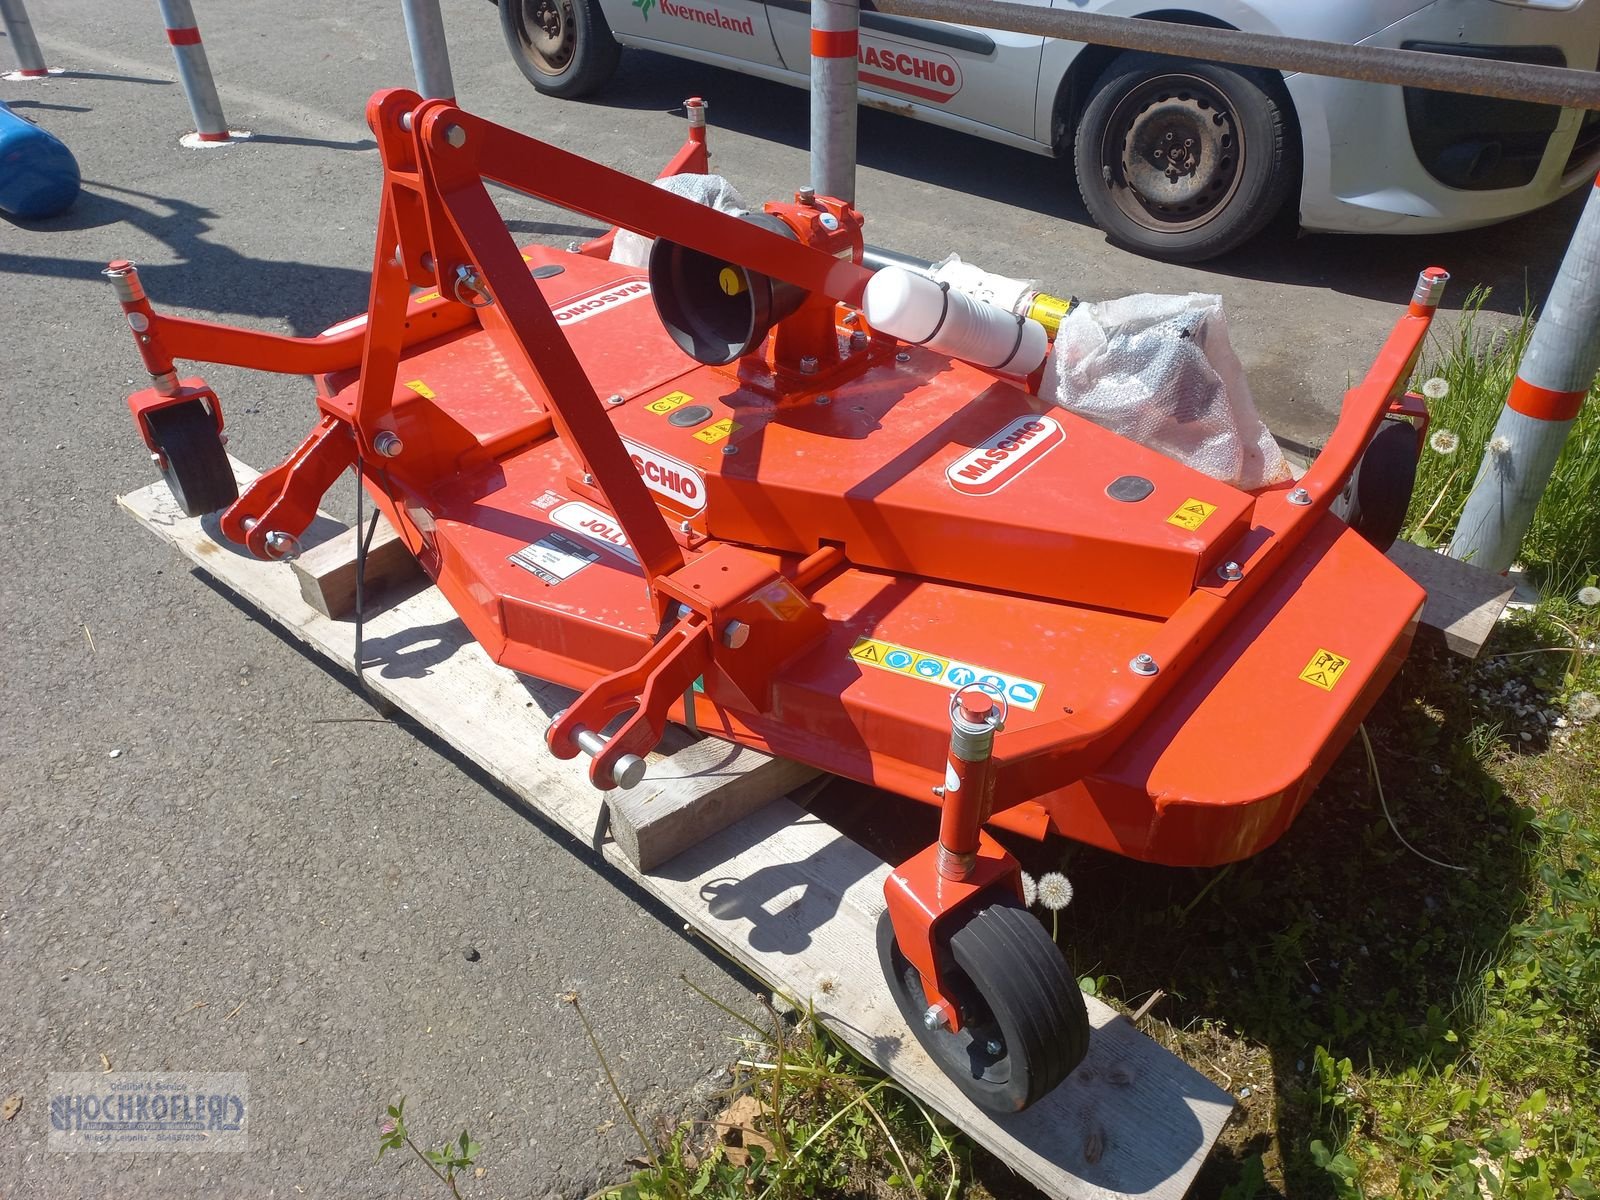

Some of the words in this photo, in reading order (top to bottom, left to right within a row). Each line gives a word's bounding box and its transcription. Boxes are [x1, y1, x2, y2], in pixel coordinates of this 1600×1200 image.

[659, 0, 755, 36] Kverneland
[555, 283, 648, 321] MASCHIO
[957, 421, 1046, 481] MASCHIO
[629, 453, 698, 499] SCHIO
[579, 519, 630, 548] JOLL
